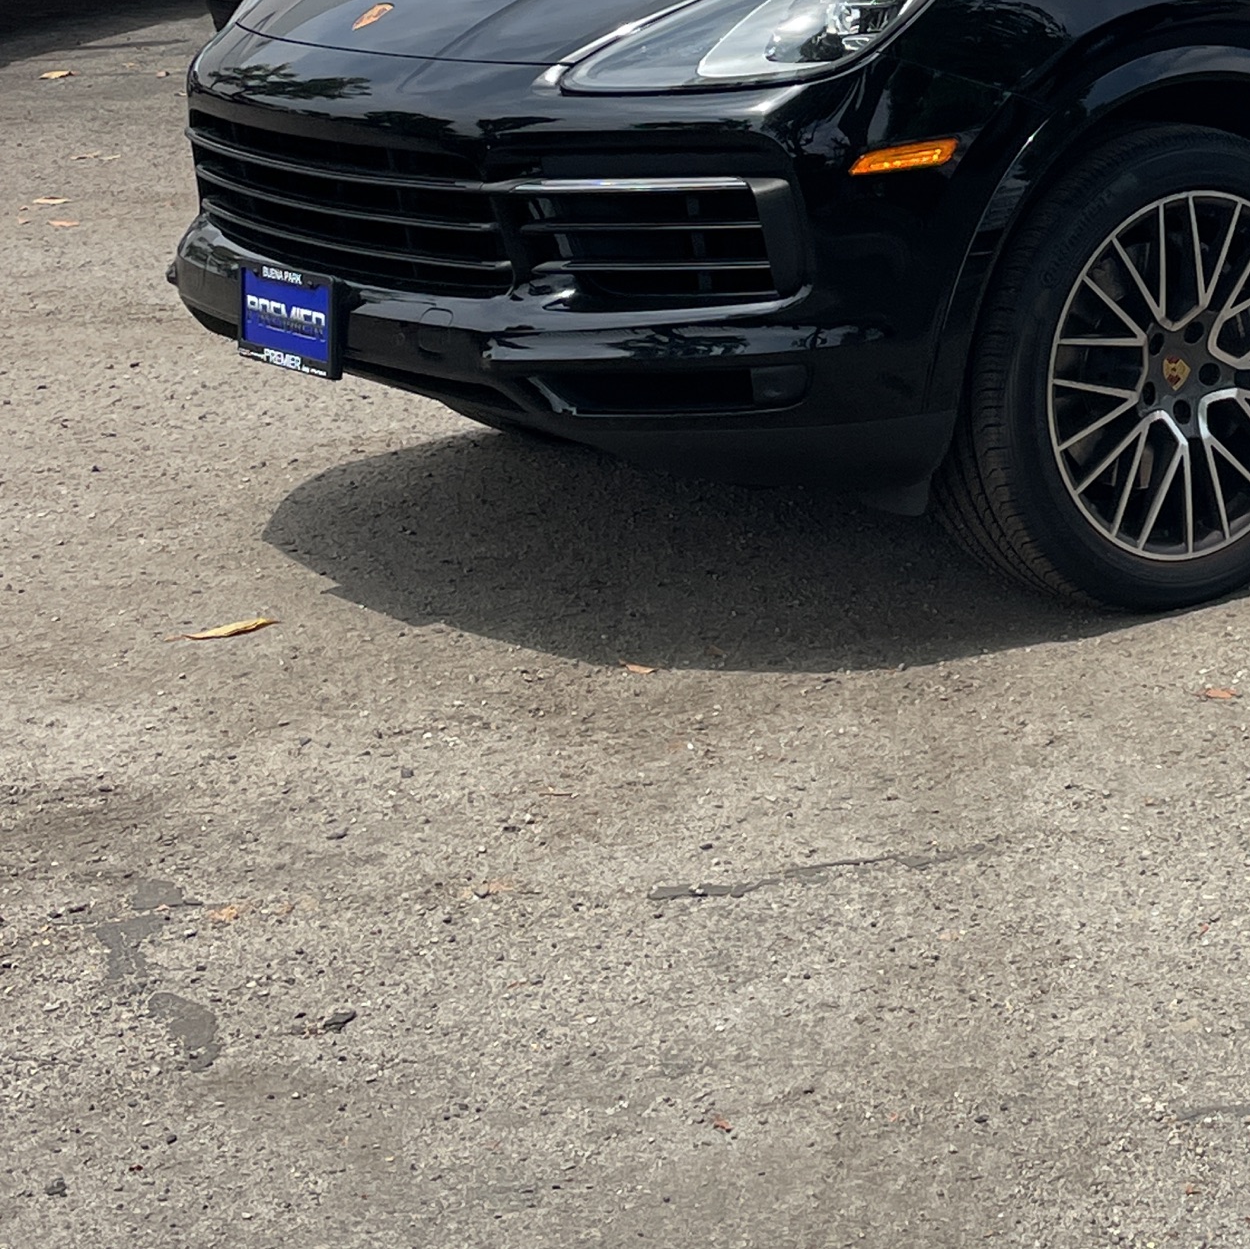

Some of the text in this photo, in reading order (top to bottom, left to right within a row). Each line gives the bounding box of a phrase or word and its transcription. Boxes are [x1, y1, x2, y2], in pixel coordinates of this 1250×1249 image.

[262, 265, 303, 286] BUENA PARK
[263, 348, 302, 371] PREMIER
